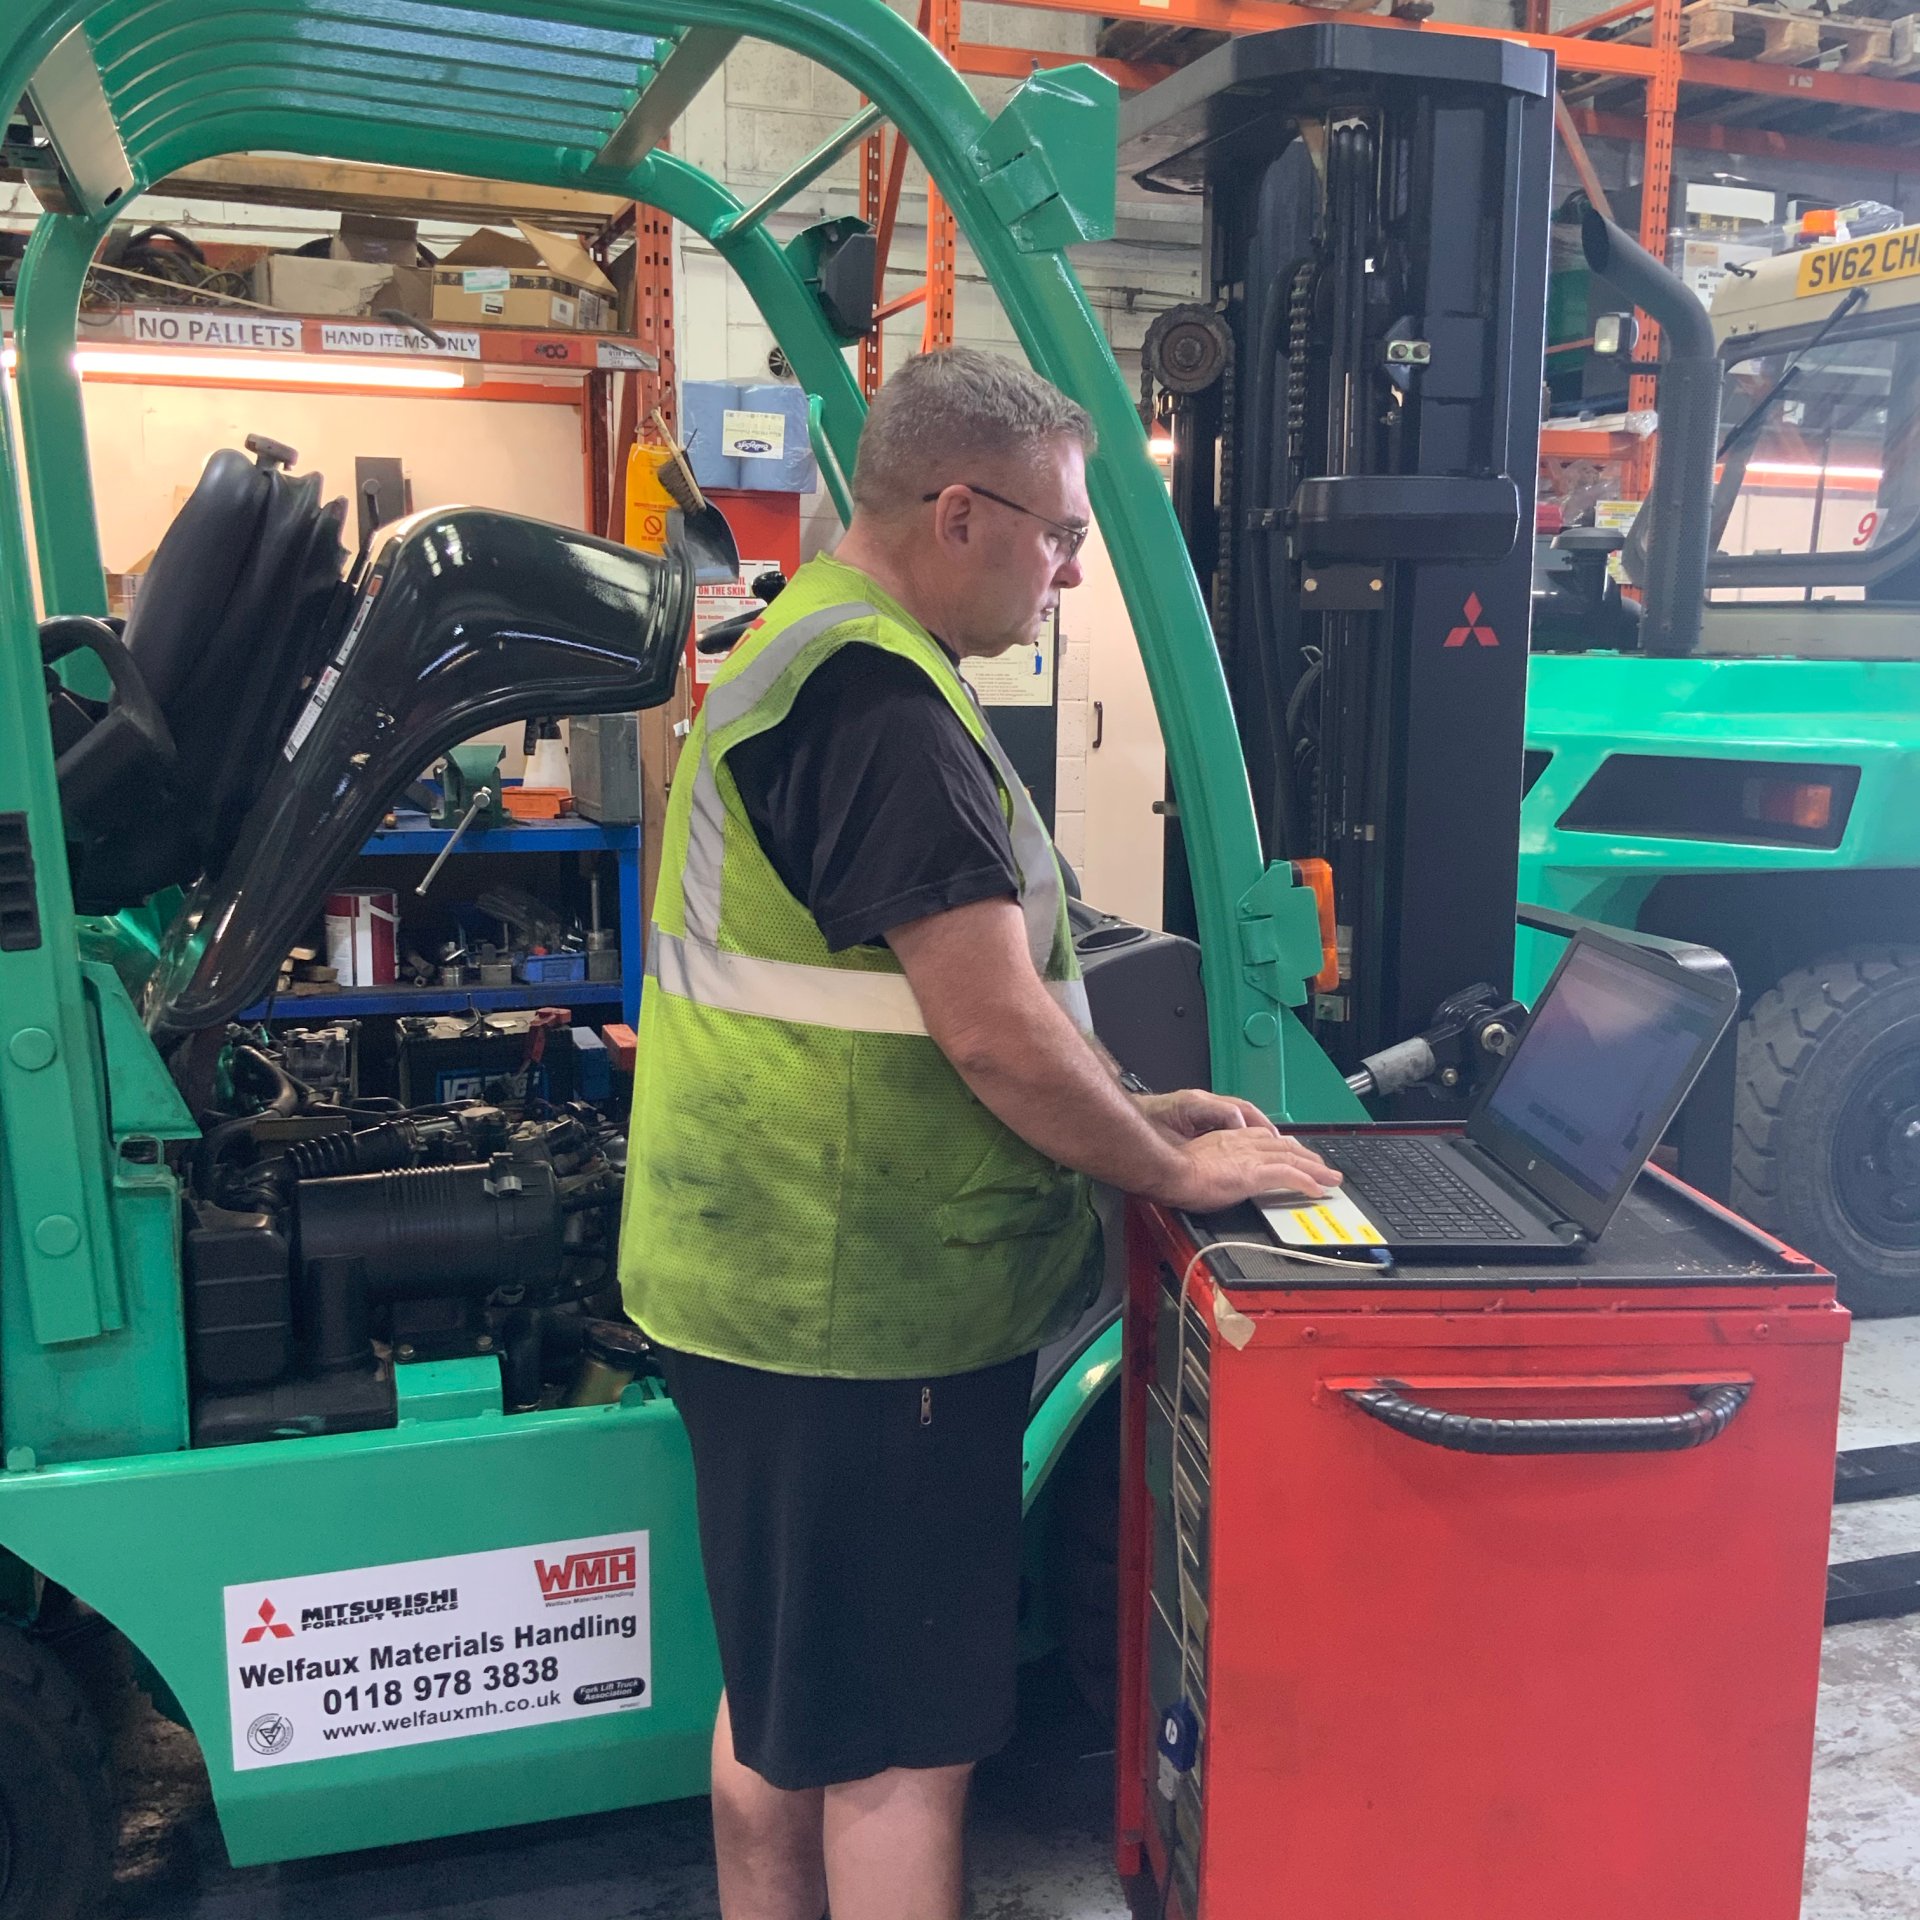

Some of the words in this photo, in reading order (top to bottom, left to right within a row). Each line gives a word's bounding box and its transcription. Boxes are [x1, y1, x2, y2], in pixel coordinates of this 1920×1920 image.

[1808, 243, 1877, 288] SV62
[1881, 232, 1920, 272] CH
[138, 317, 179, 340] NO
[188, 320, 296, 348] PALLETS
[324, 330, 375, 346] HAND
[379, 333, 430, 350] ITEMS
[434, 337, 478, 352] NLY
[1852, 511, 1878, 546] 9
[698, 586, 710, 595] ON
[711, 586, 726, 596] THE
[727, 586, 746, 596] SKIN
[534, 1547, 636, 1593] WMH
[301, 1587, 458, 1624] MITSUBISHI
[301, 1612, 385, 1631] FORKLIFT
[391, 1602, 459, 1618] TRUCKS
[239, 1656, 360, 1689] Welfaux
[370, 1631, 505, 1671] Materials
[514, 1614, 637, 1649] Handling
[323, 1679, 403, 1715] 0118
[413, 1669, 472, 1702] 978
[483, 1655, 559, 1692] 3838
[580, 1685, 599, 1694] Fork
[600, 1682, 615, 1692] Lift
[616, 1680, 639, 1689] Truck
[584, 1688, 633, 1701] Association
[323, 1690, 561, 1741] www.welfauxmh.co.uk
